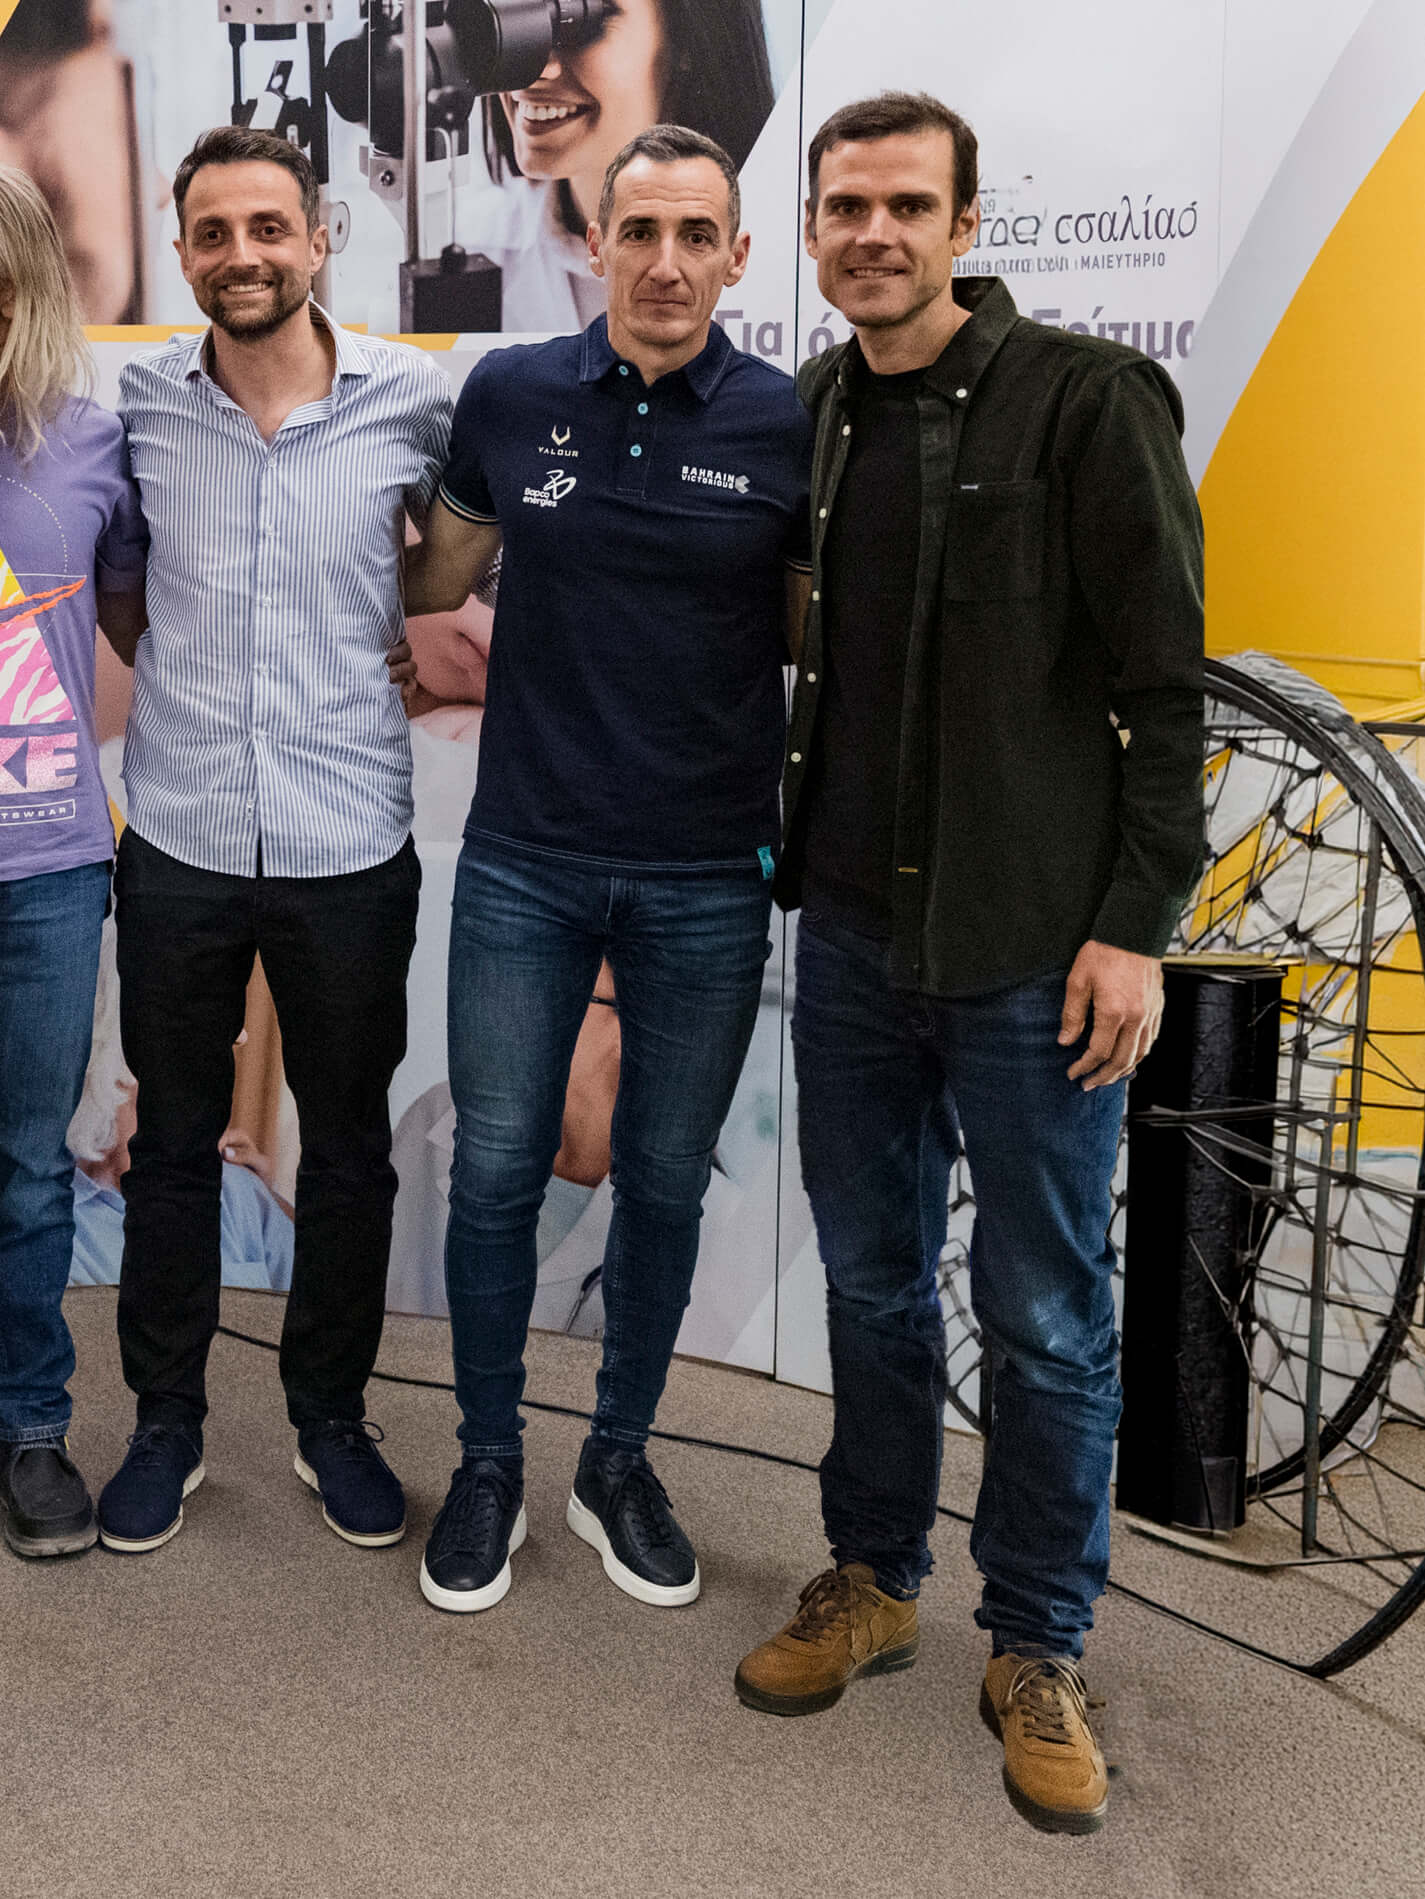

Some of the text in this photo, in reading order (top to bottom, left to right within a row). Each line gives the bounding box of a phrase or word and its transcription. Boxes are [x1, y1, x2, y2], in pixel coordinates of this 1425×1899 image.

[538, 446, 579, 457] VALOUR
[681, 465, 735, 483] BAHRAIN
[681, 474, 734, 490] VICTORIOUS
